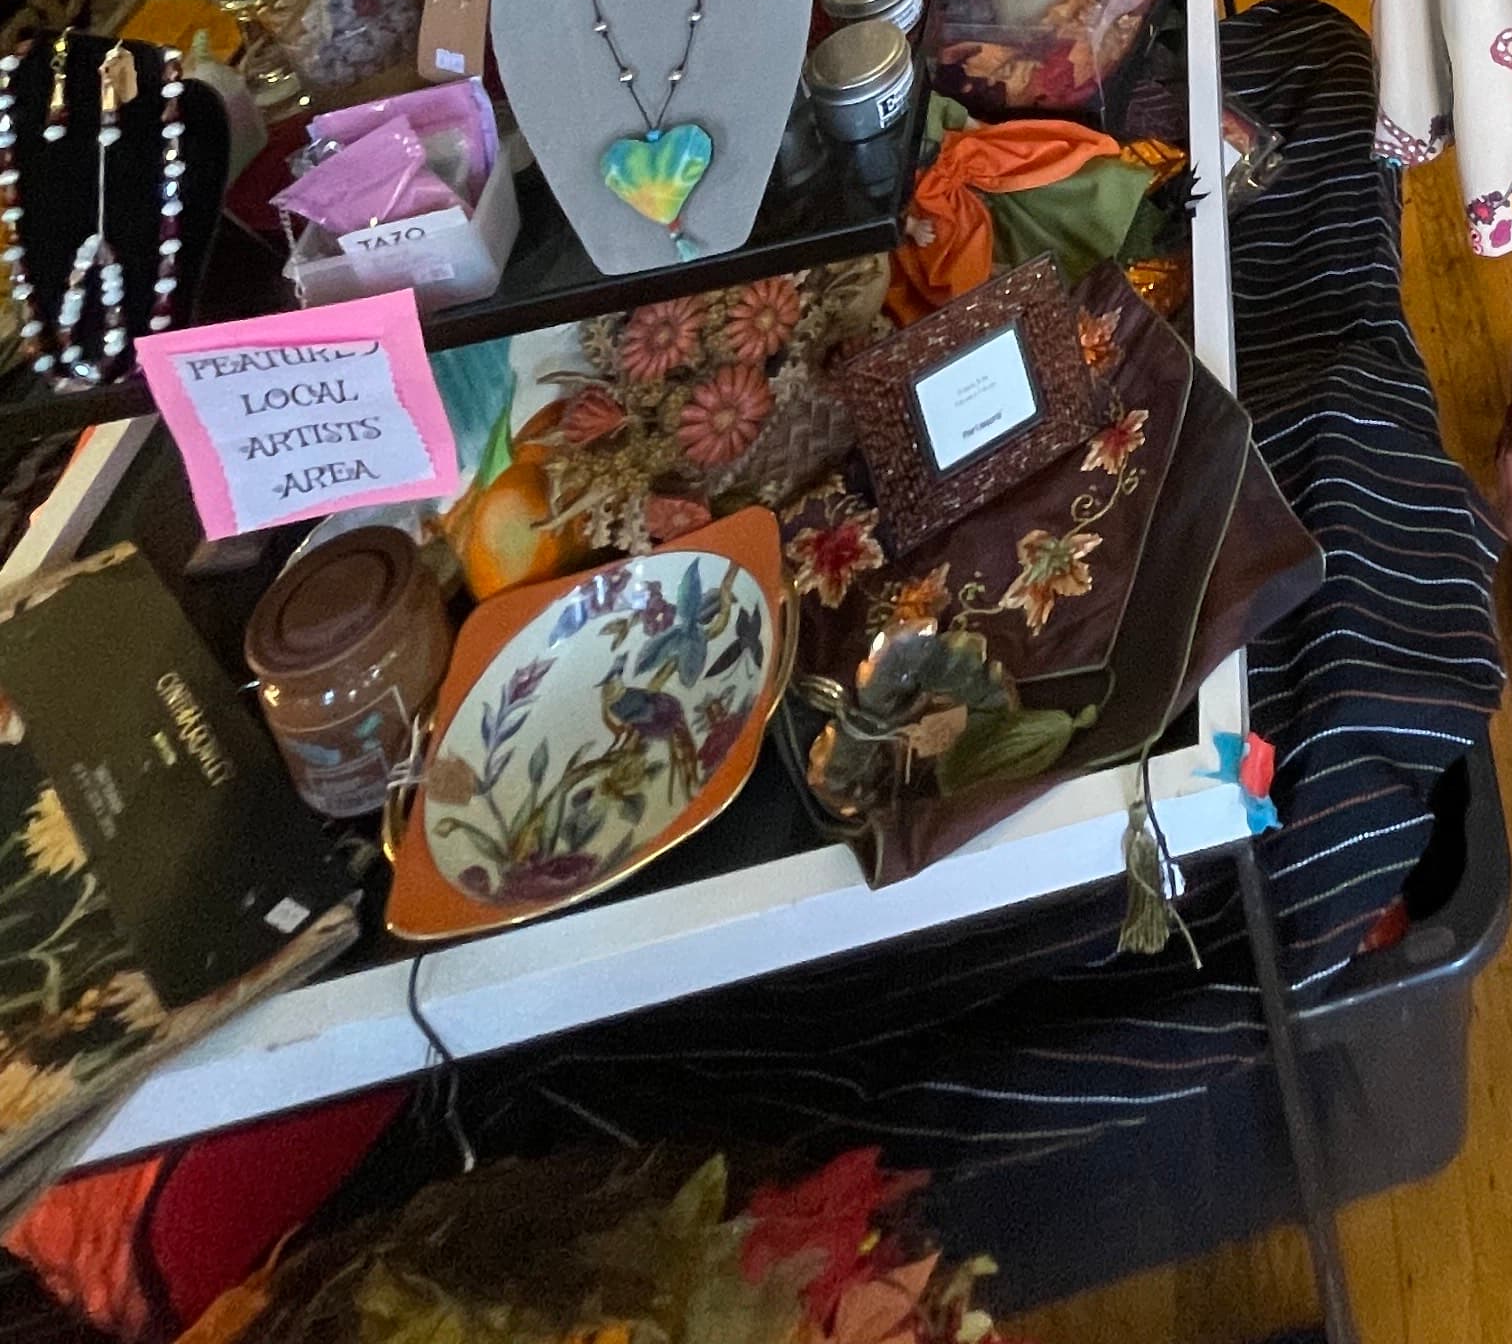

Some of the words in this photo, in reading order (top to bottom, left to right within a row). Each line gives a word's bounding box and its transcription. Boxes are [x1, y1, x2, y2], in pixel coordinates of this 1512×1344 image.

[239, 379, 360, 416] LOCAL
[238, 416, 383, 461] ARTISTS
[272, 459, 381, 500] AREA
